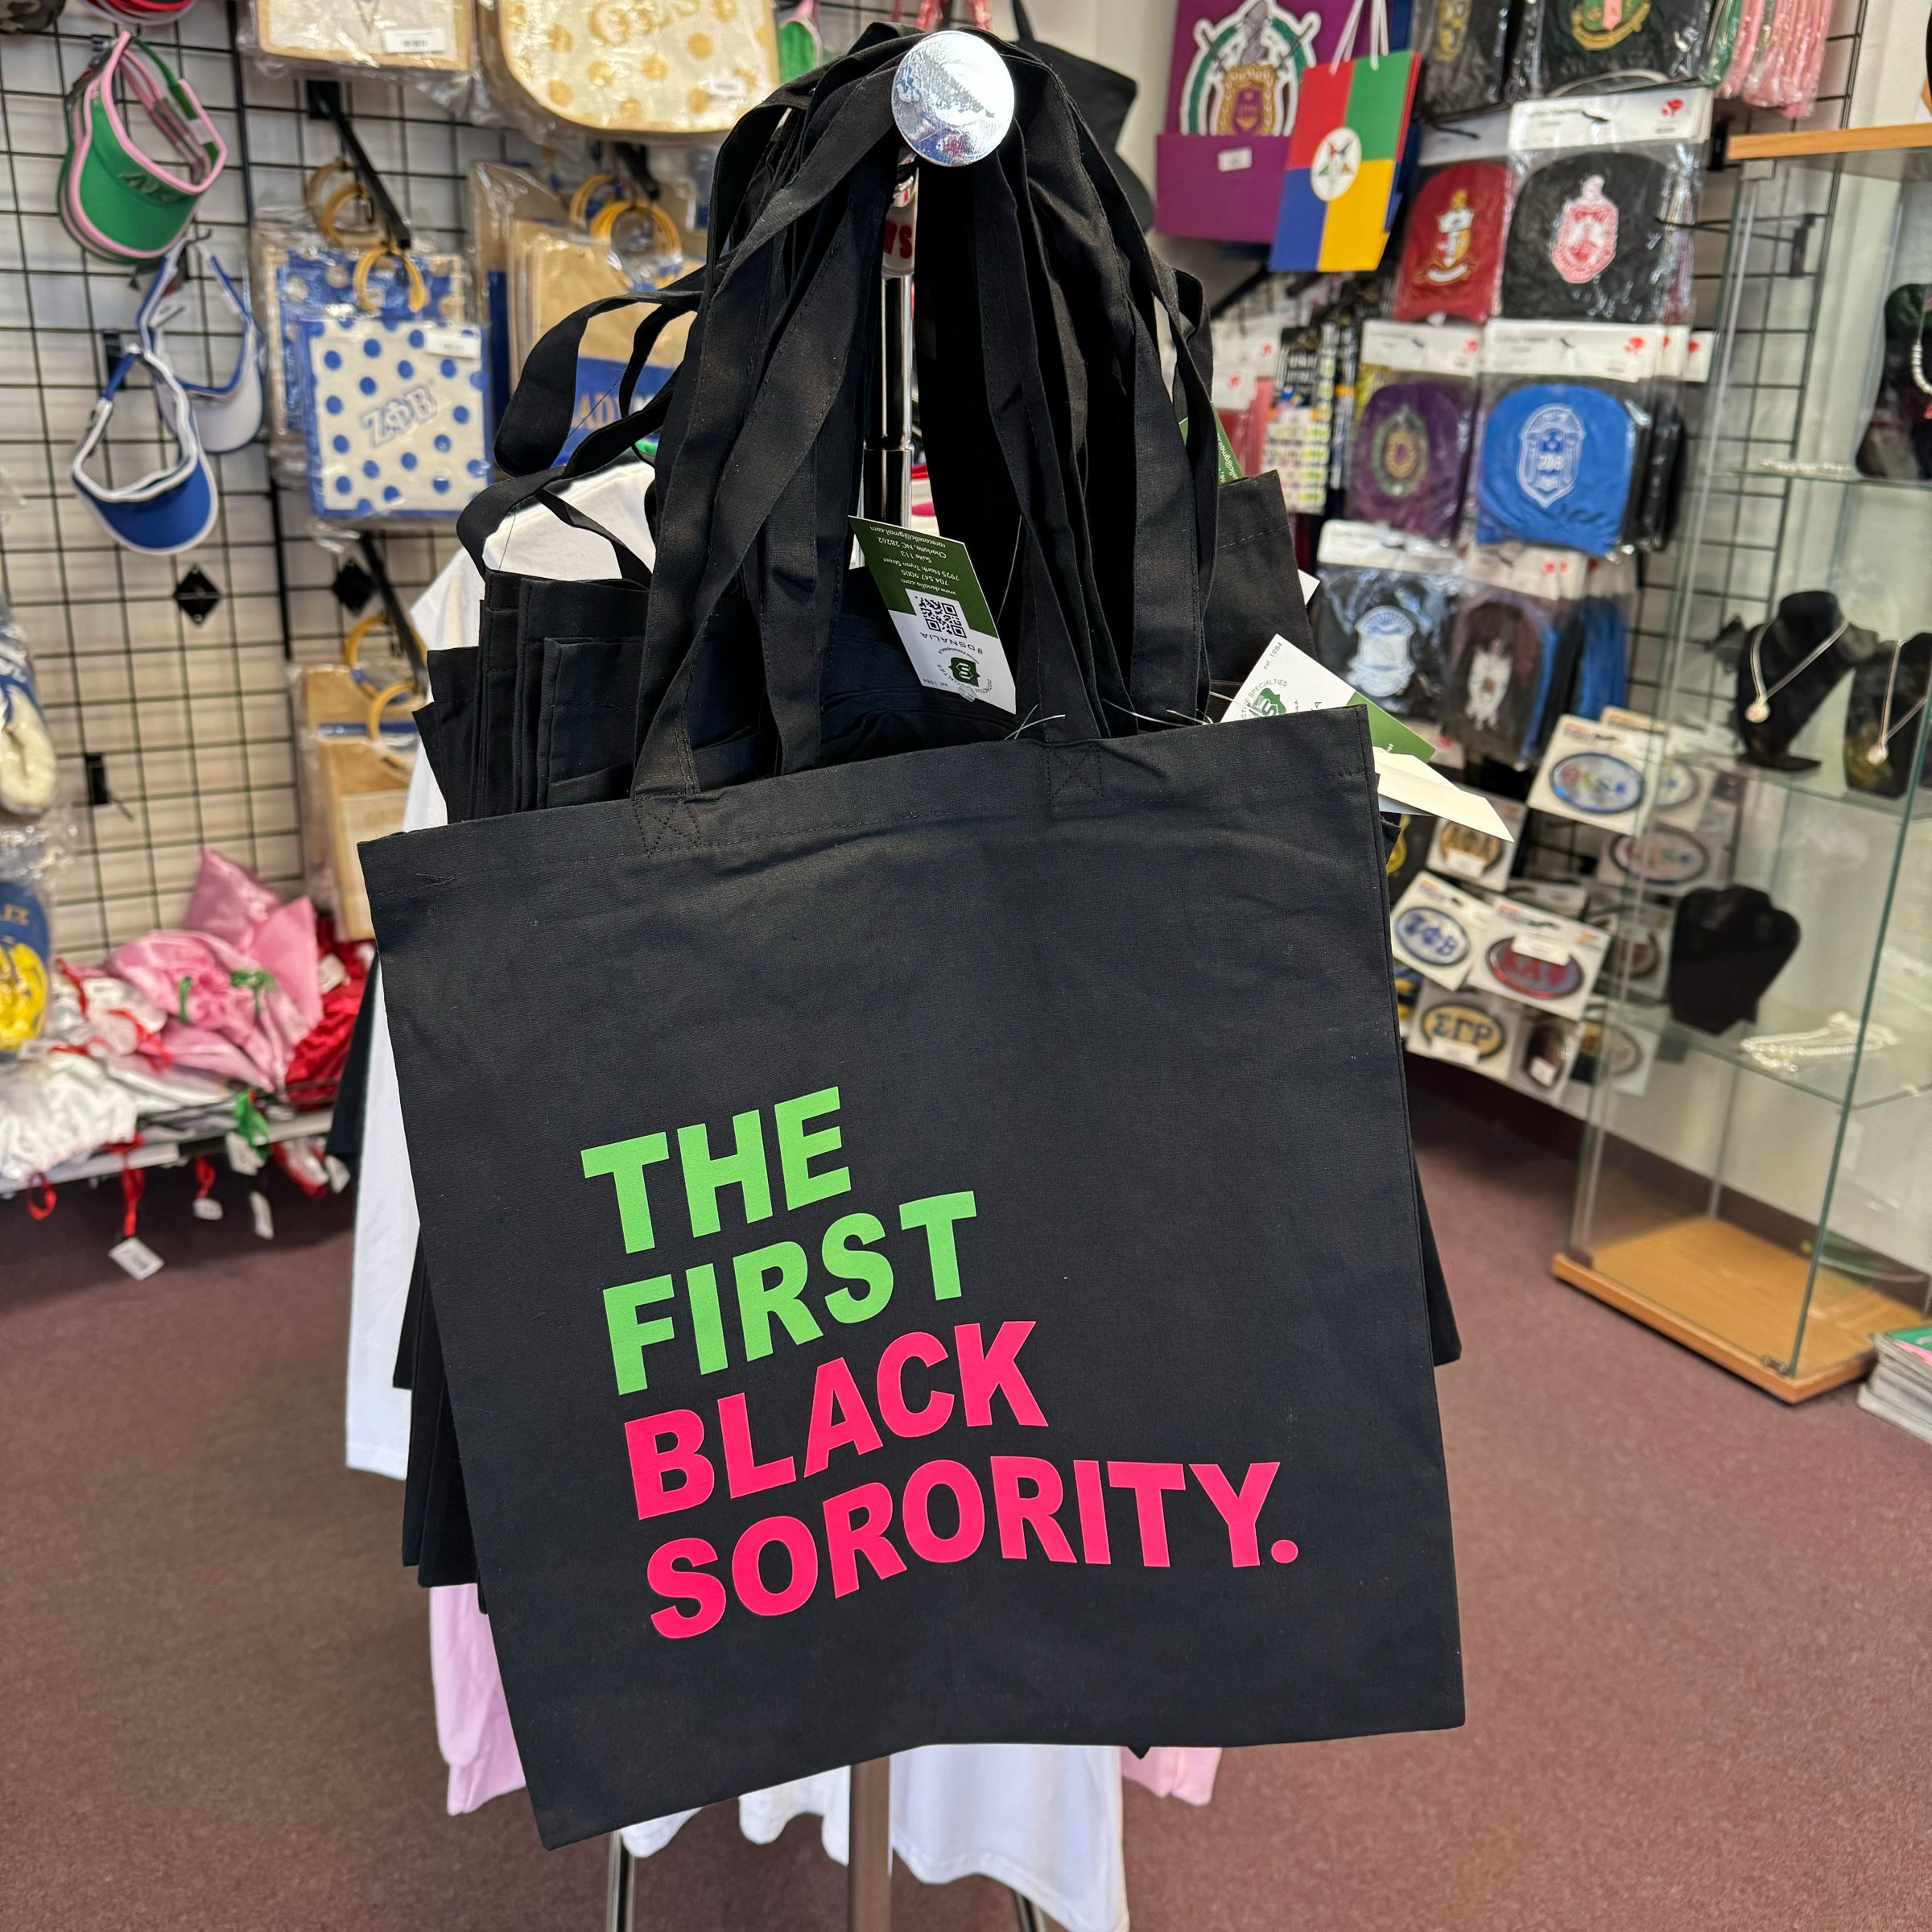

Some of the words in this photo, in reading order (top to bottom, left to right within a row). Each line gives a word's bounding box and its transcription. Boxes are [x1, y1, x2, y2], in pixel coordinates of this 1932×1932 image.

[877, 536, 900, 548] 28262
[902, 542, 913, 550] NC
[882, 557, 902, 567] Street
[900, 550, 914, 559] 113
[915, 554, 932, 564] Suite
[902, 561, 920, 571] Tryon
[921, 566, 941, 576] North
[901, 569, 949, 586] 704.547.9005
[942, 571, 960, 581] 7925
[900, 578, 957, 596] www.dsnalia.com
[920, 632, 984, 654] #DSNALIA
[1269, 642, 1283, 658] 1984
[1248, 679, 1288, 700] SPECIALTIES
[580, 1086, 852, 1254] THE
[602, 1191, 977, 1395] FIRST
[624, 1320, 1049, 1521] BLACK
[646, 1455, 1299, 1640] SORORITY.
